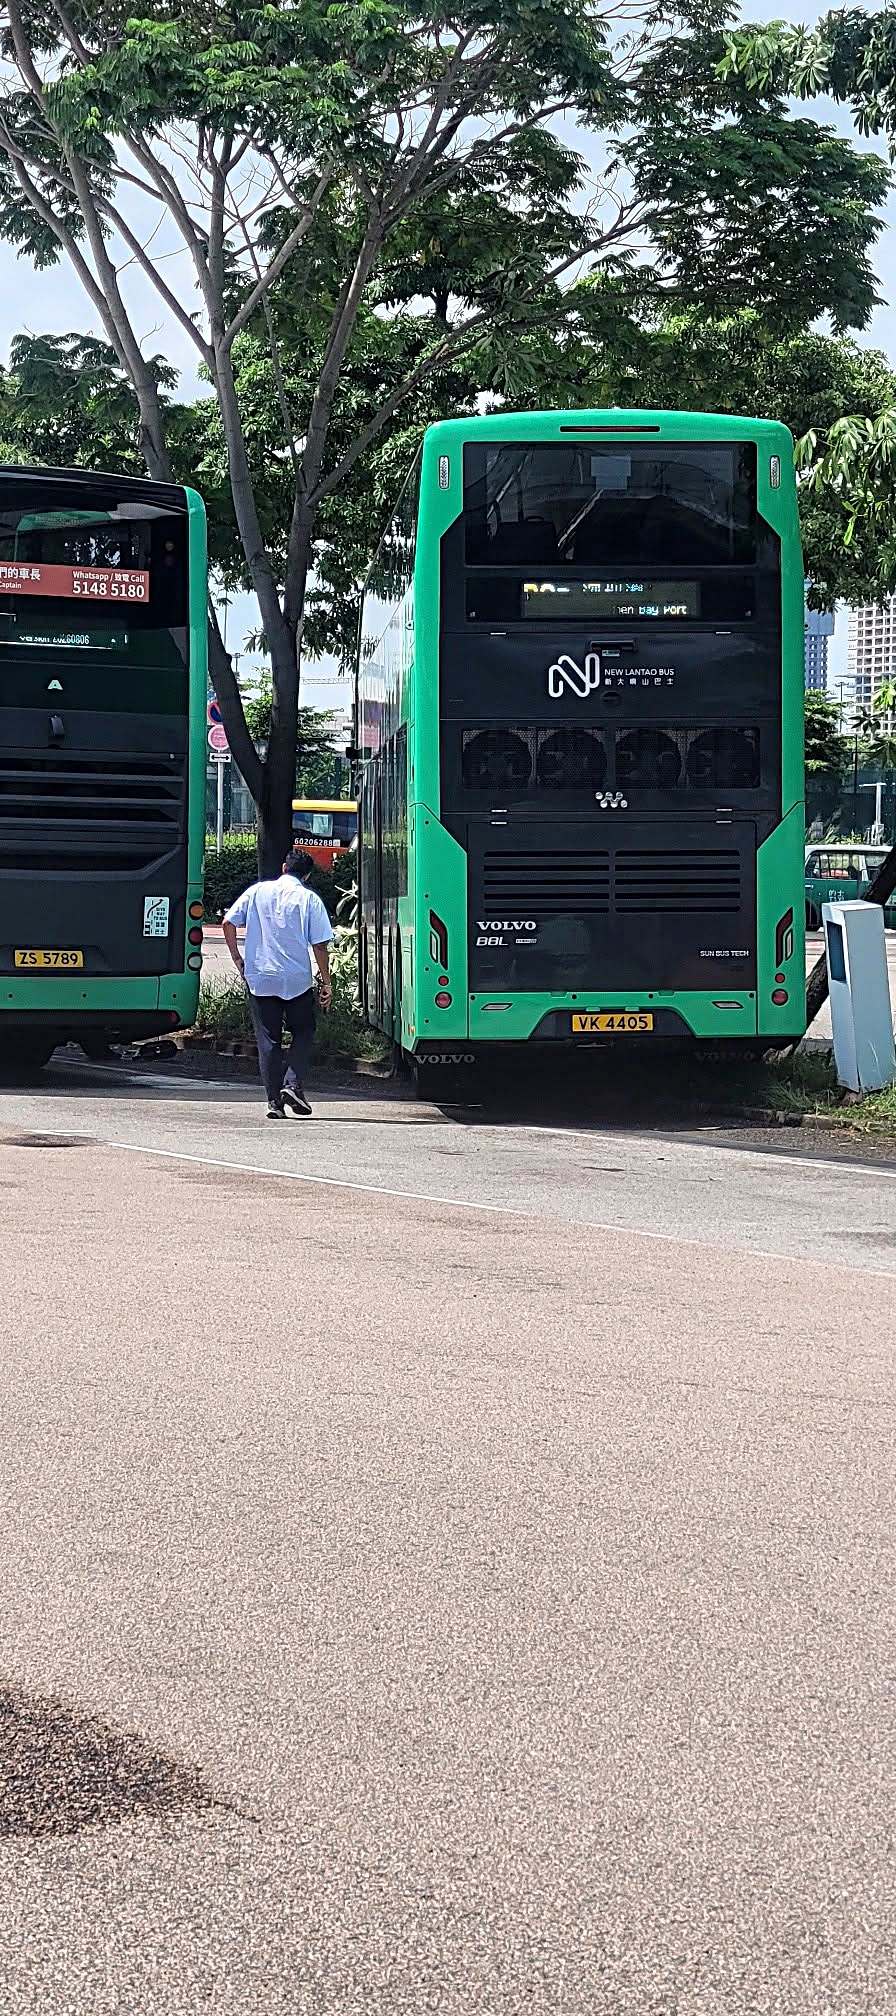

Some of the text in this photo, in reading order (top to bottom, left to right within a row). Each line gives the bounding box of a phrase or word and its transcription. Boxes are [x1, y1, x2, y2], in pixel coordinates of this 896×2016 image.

[73, 570, 109, 582] Whatsapp
[130, 575, 145, 583] Call
[72, 581, 145, 598] 5148 5180
[604, 668, 675, 676] NEW LANTAO BUS
[476, 921, 537, 931] VOLVO
[19, 952, 79, 965] ZS 5789
[578, 1016, 648, 1030] VK 4405
[413, 1054, 475, 1064] VOLVO
